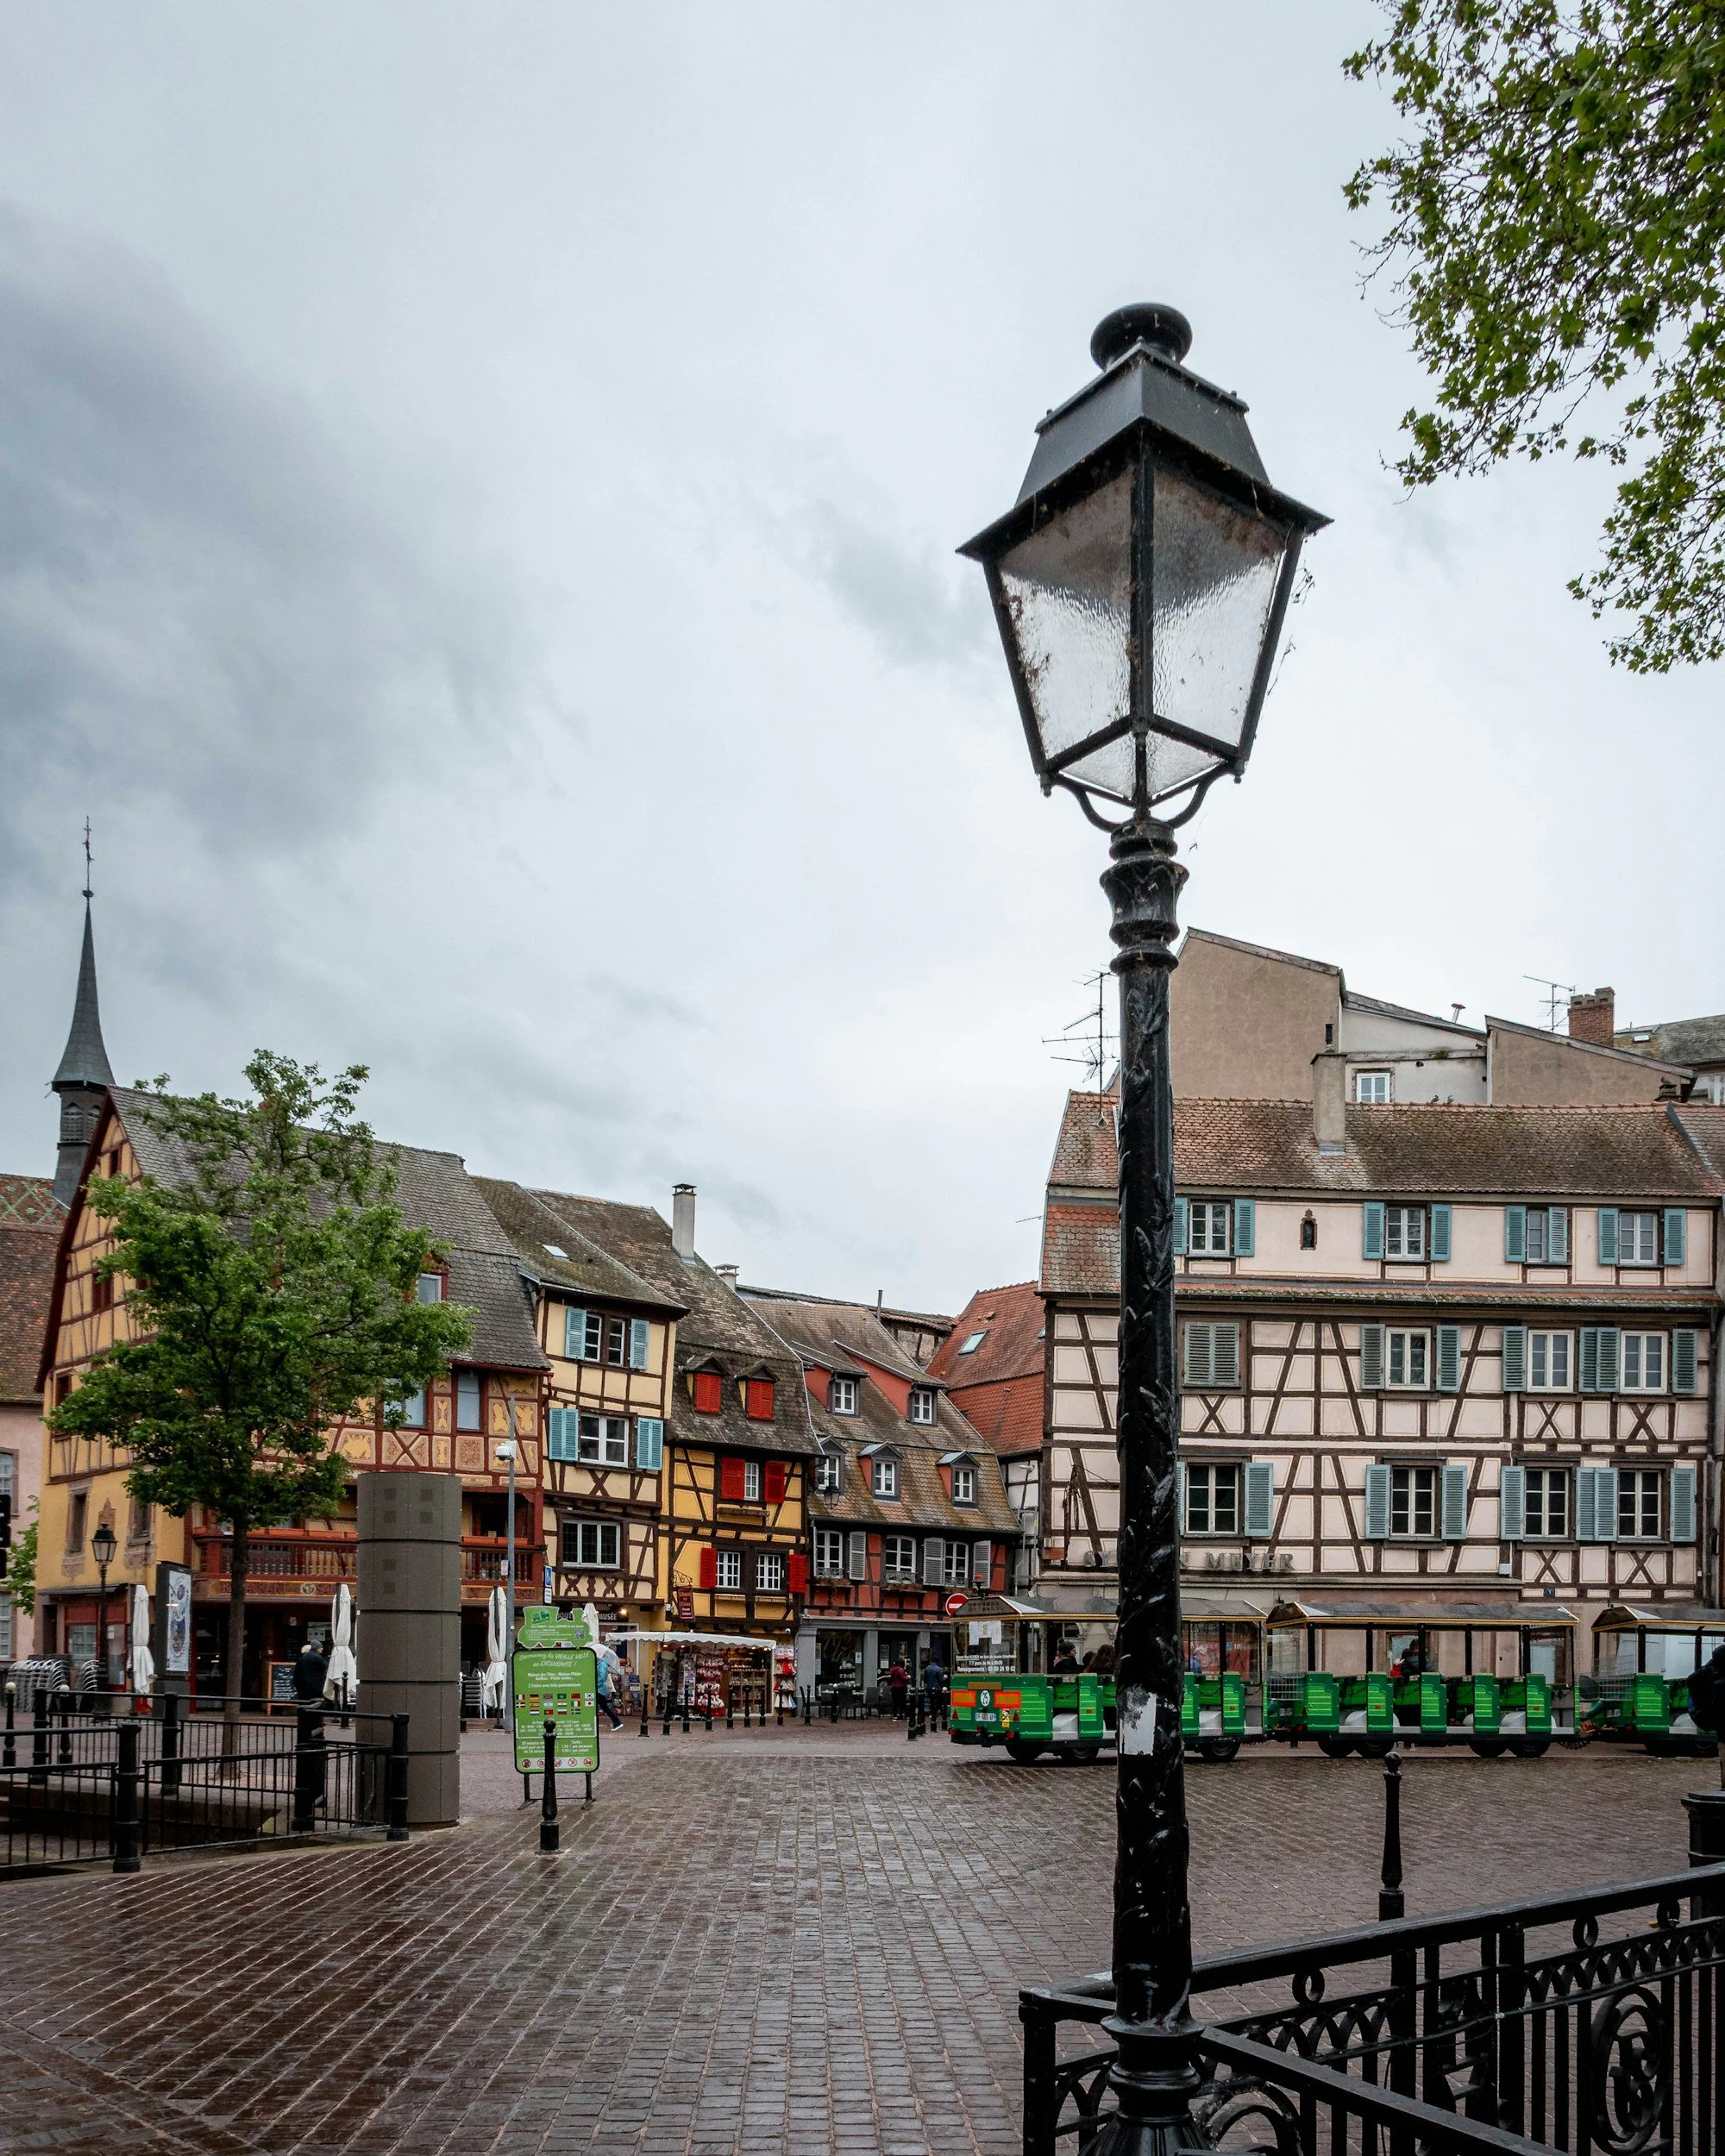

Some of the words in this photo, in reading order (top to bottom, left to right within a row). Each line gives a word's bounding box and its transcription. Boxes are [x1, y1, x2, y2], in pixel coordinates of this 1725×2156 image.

[1205, 1552, 1295, 1570] MEYER
[598, 1612, 618, 1620] MUSÉE
[982, 1692, 988, 1704] 25
